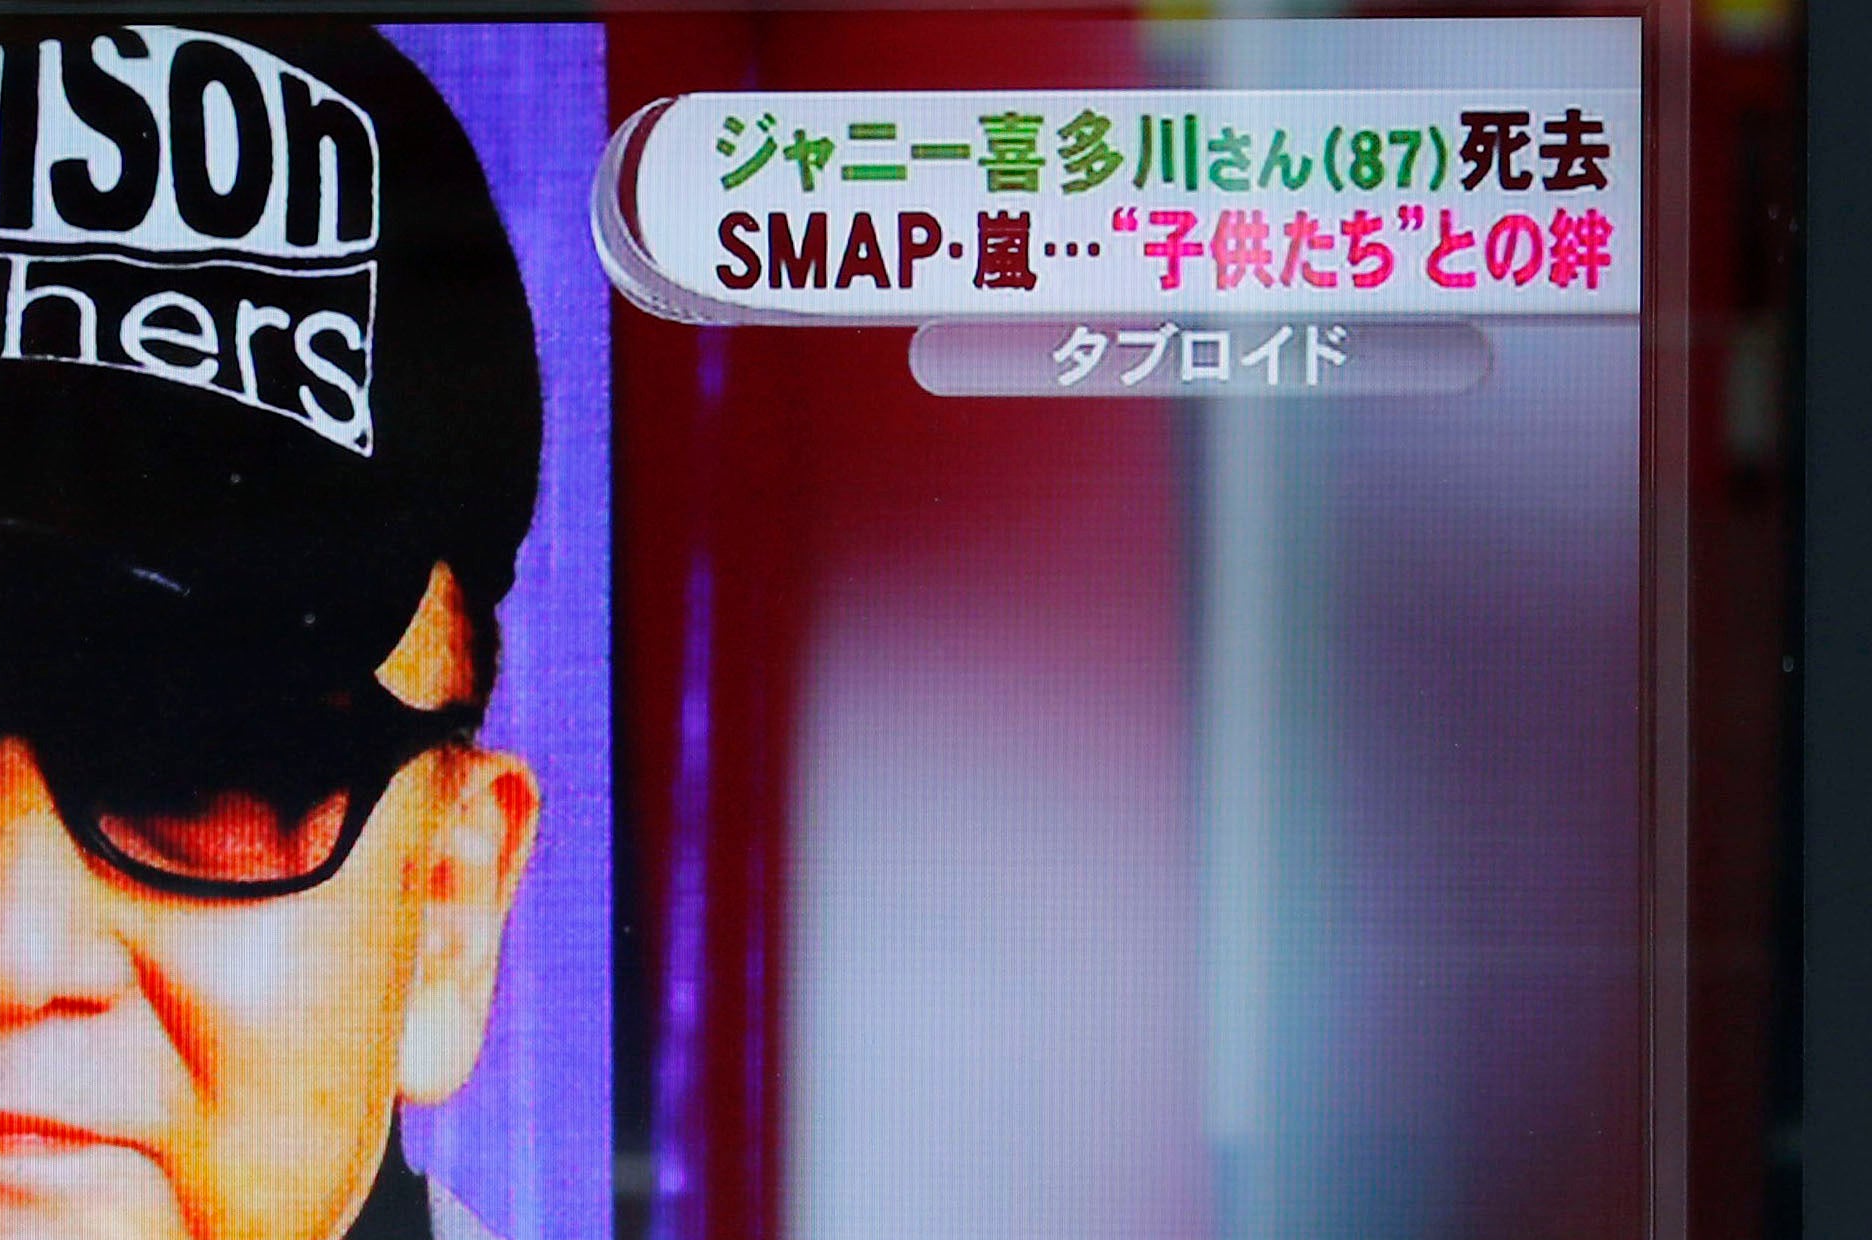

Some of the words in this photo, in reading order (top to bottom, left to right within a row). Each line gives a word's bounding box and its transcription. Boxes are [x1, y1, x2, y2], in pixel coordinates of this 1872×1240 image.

[1052, 321, 1348, 387] タブロイド
